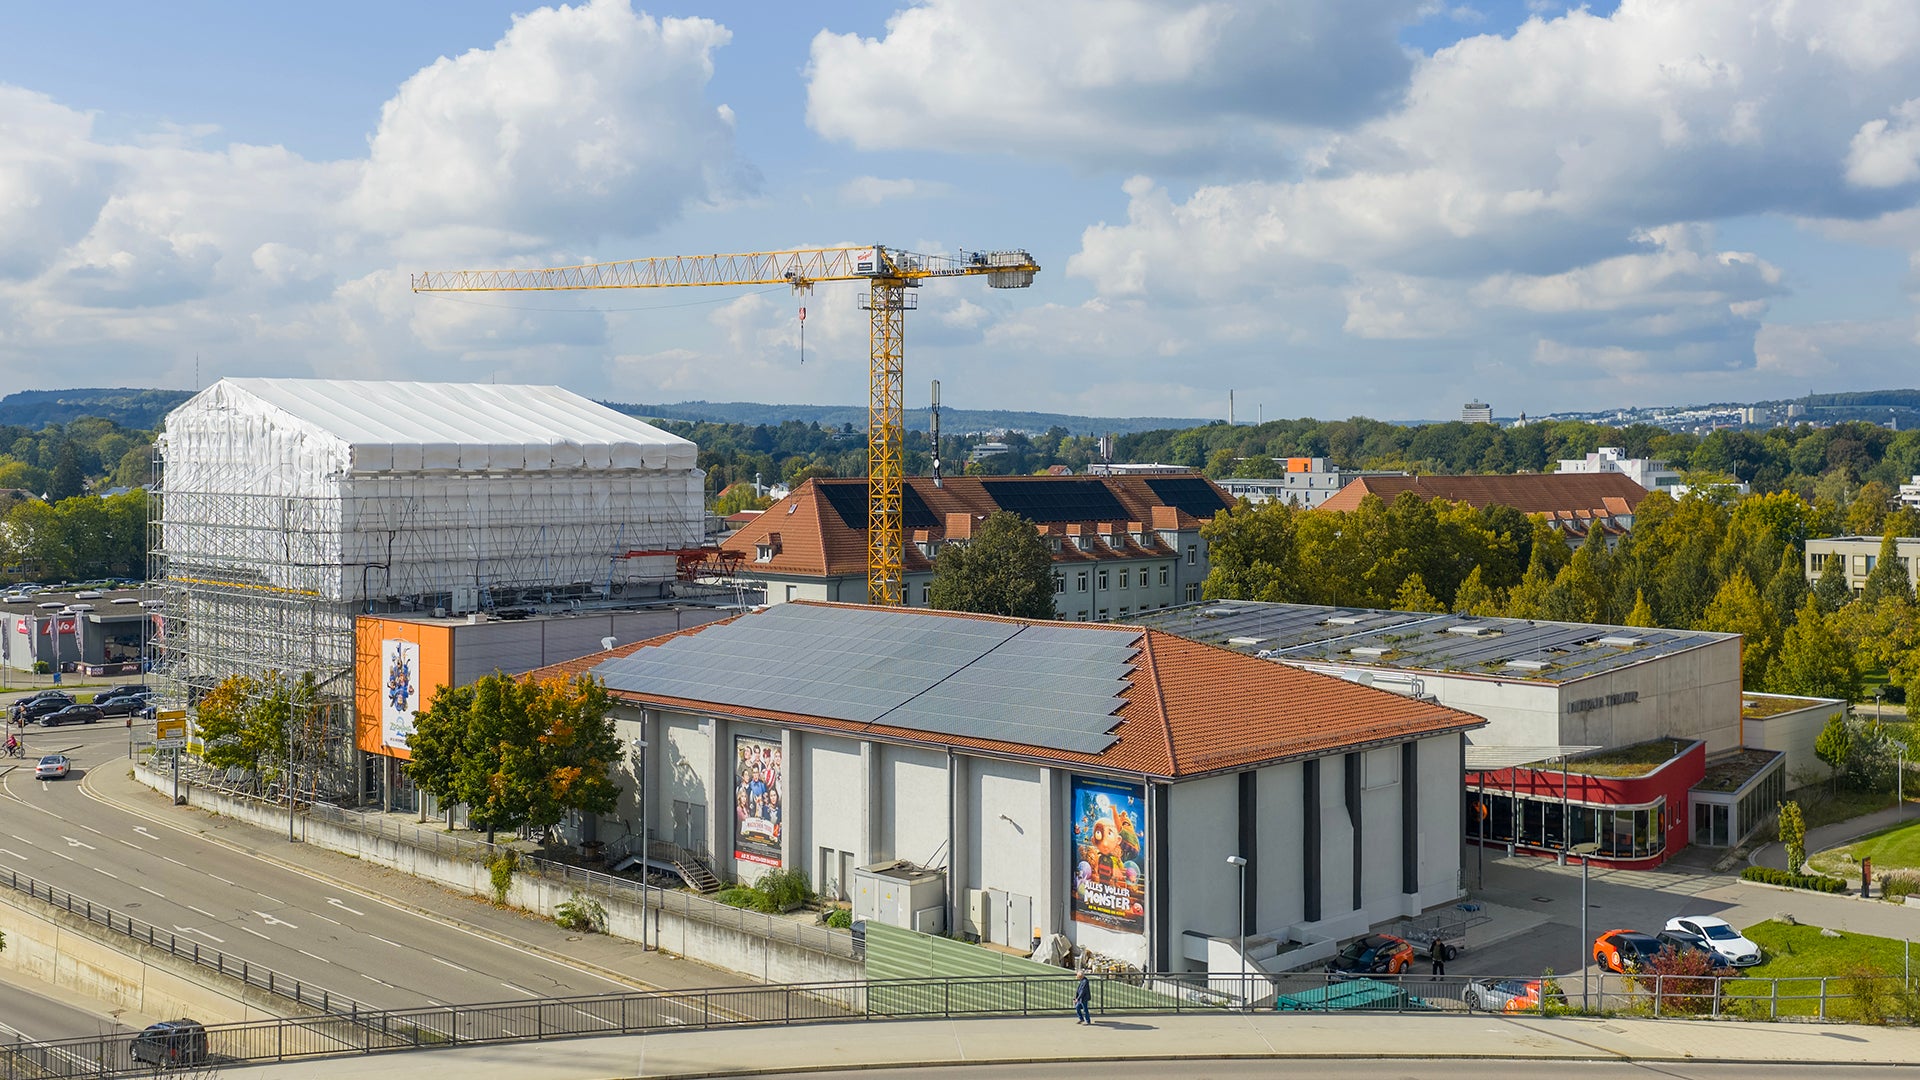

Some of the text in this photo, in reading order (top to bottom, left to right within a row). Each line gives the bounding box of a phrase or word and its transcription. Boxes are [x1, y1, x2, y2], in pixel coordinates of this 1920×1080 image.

[1084, 880, 1130, 898] ALLES VOLLER
[1084, 889, 1130, 910] MONSTER
